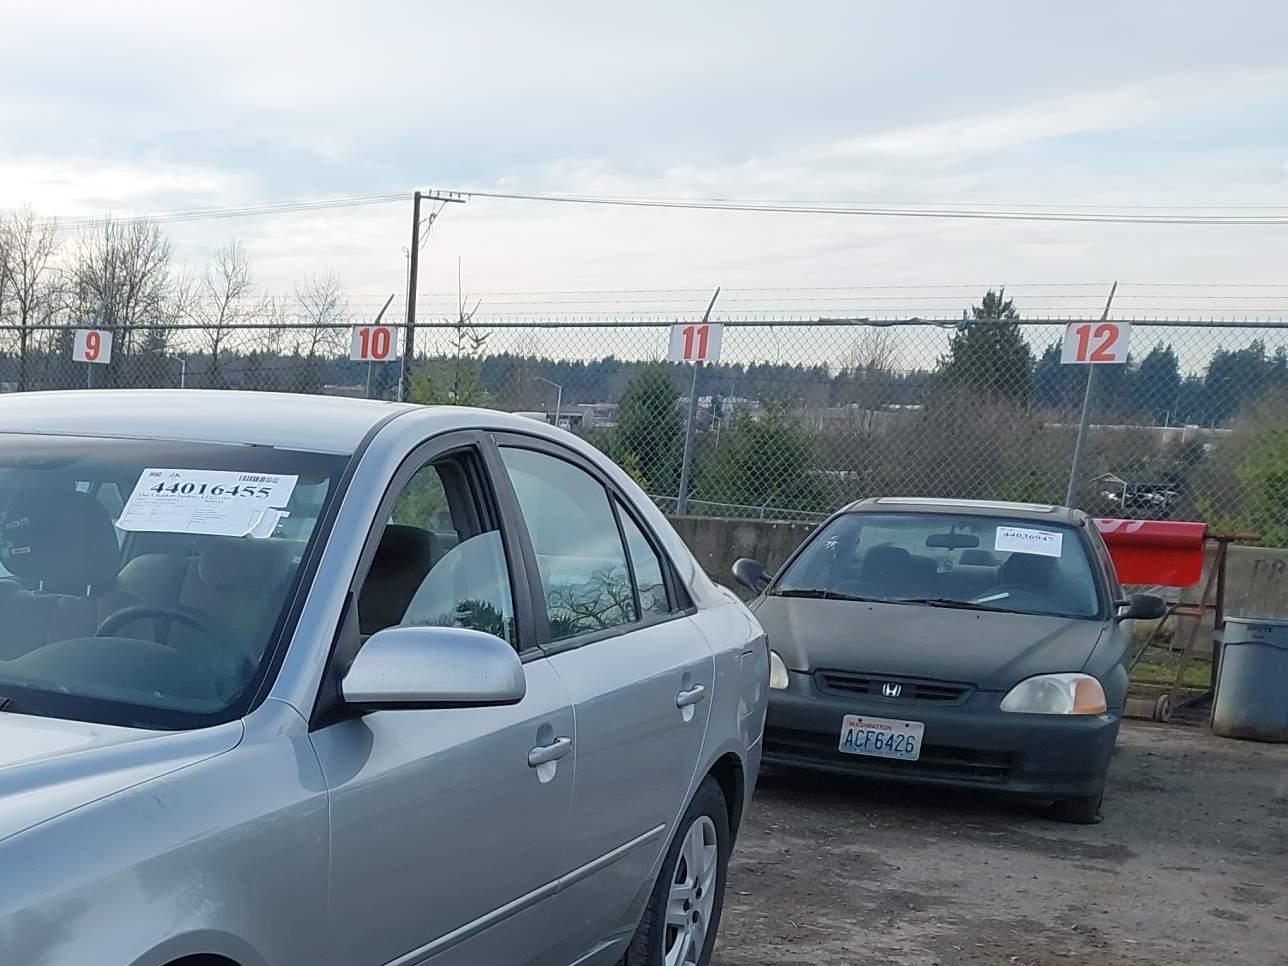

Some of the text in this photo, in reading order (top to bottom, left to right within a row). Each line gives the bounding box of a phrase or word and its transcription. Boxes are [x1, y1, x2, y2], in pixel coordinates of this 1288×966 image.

[84, 331, 100, 360] 9
[359, 328, 390, 359] 10
[682, 325, 709, 360] 11
[1075, 323, 1119, 362] 12
[150, 481, 273, 499] 44016455
[844, 729, 916, 753] ACF6426
